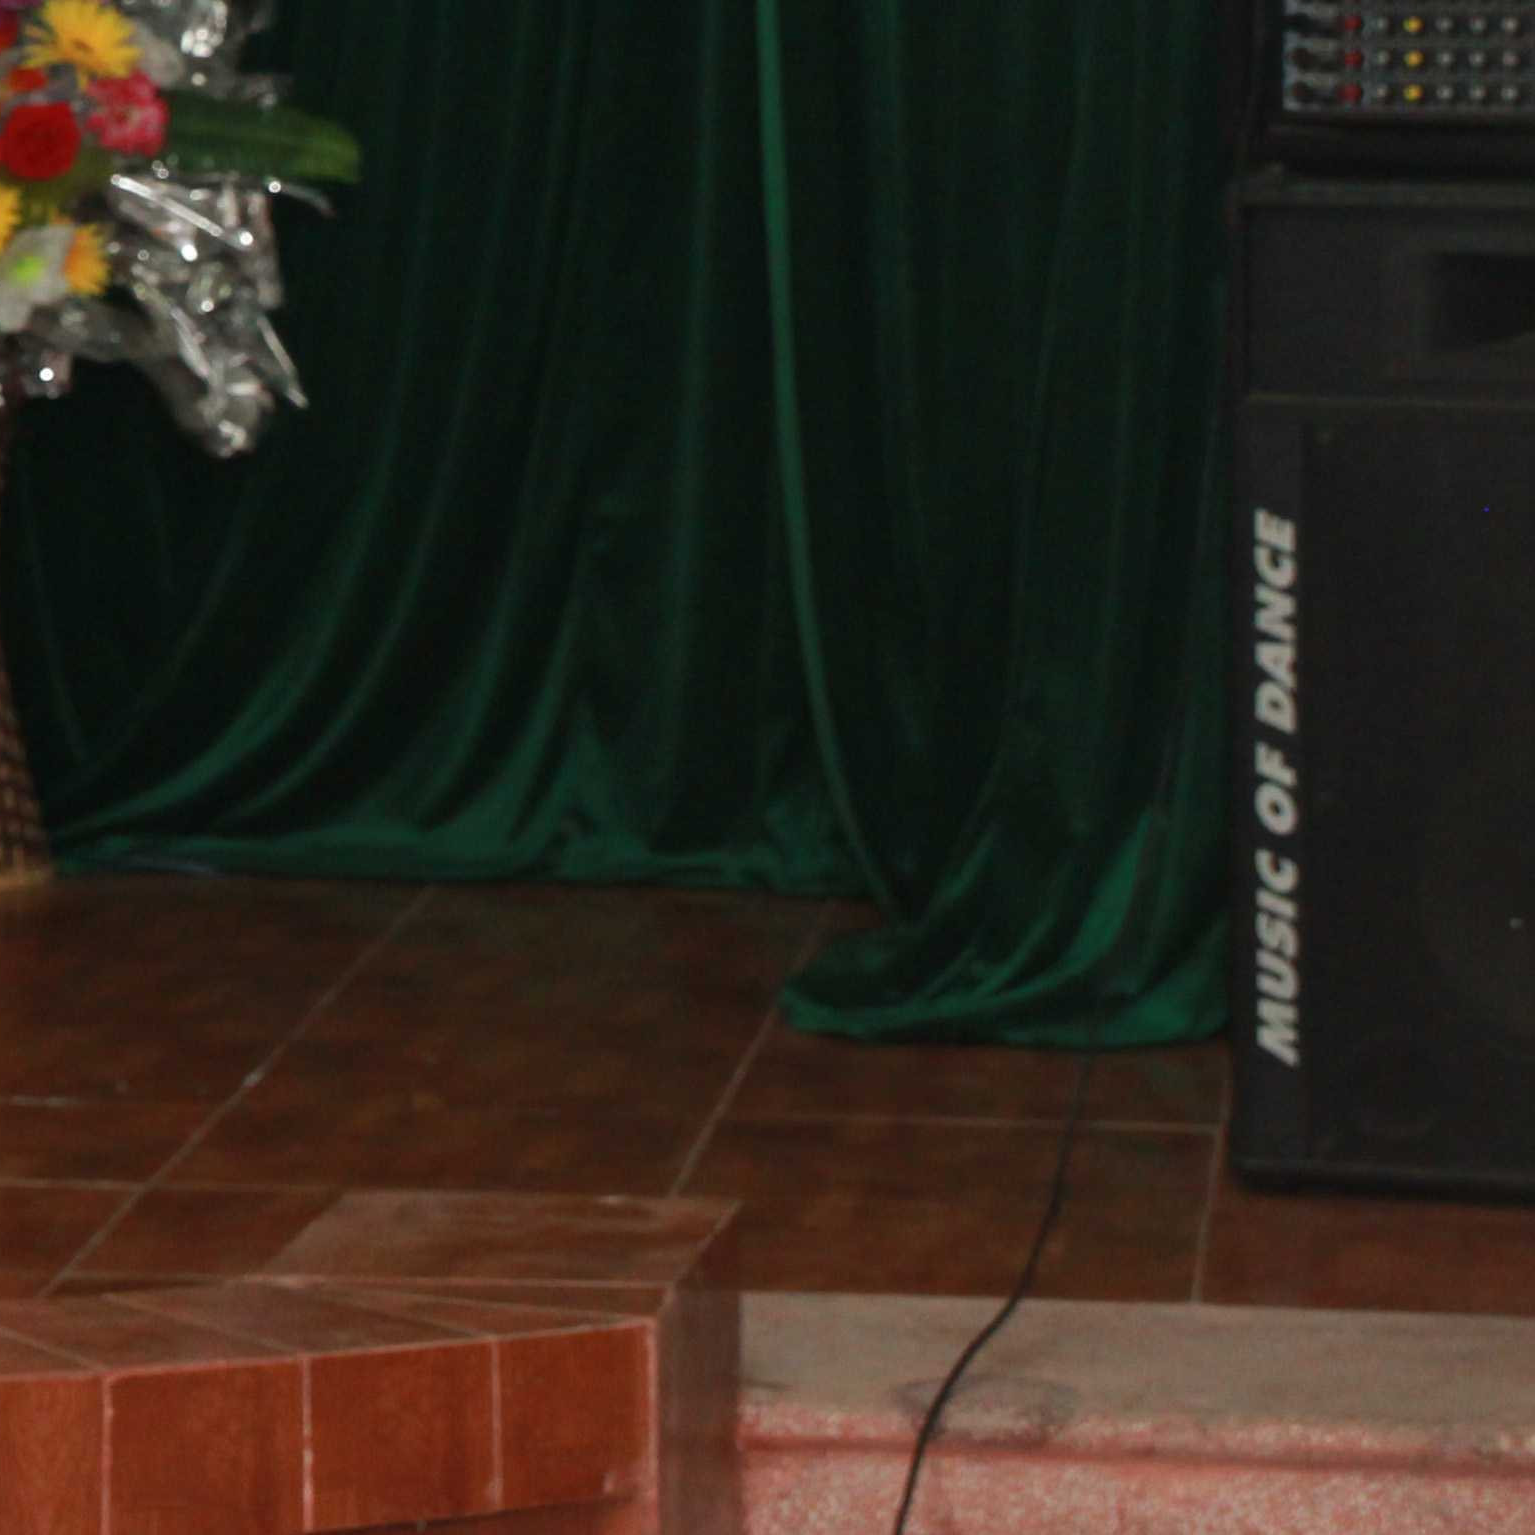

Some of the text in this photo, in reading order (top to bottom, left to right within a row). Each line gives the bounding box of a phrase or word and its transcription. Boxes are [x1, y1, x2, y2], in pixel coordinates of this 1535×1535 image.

[1253, 507, 1300, 1067] MUSIC OF DANCE
